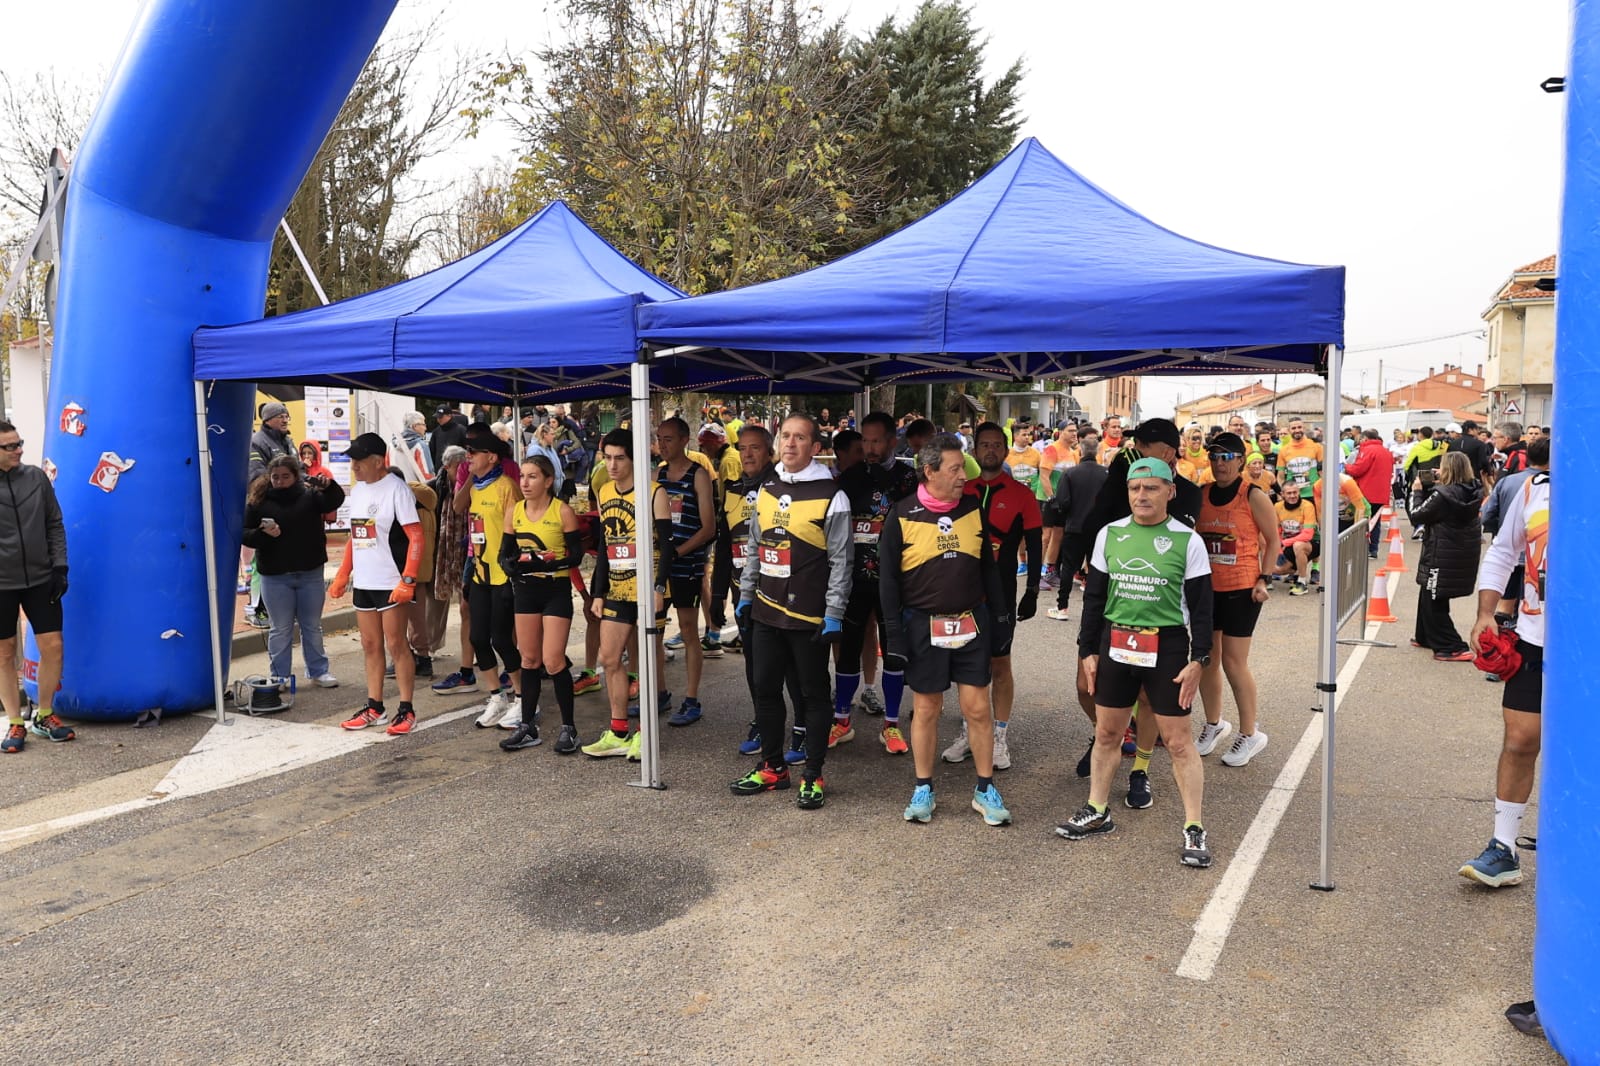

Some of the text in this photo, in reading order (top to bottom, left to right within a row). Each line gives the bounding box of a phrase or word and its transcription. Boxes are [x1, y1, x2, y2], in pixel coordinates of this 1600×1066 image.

[355, 527, 368, 537] 59
[856, 522, 871, 532] 50
[937, 541, 960, 551] CROSS
[1211, 542, 1221, 553] 11
[615, 546, 629, 558] 39
[764, 549, 778, 563] 55
[1118, 581, 1155, 592] RUNNING
[944, 621, 961, 634] 57
[1126, 634, 1138, 650] 4
